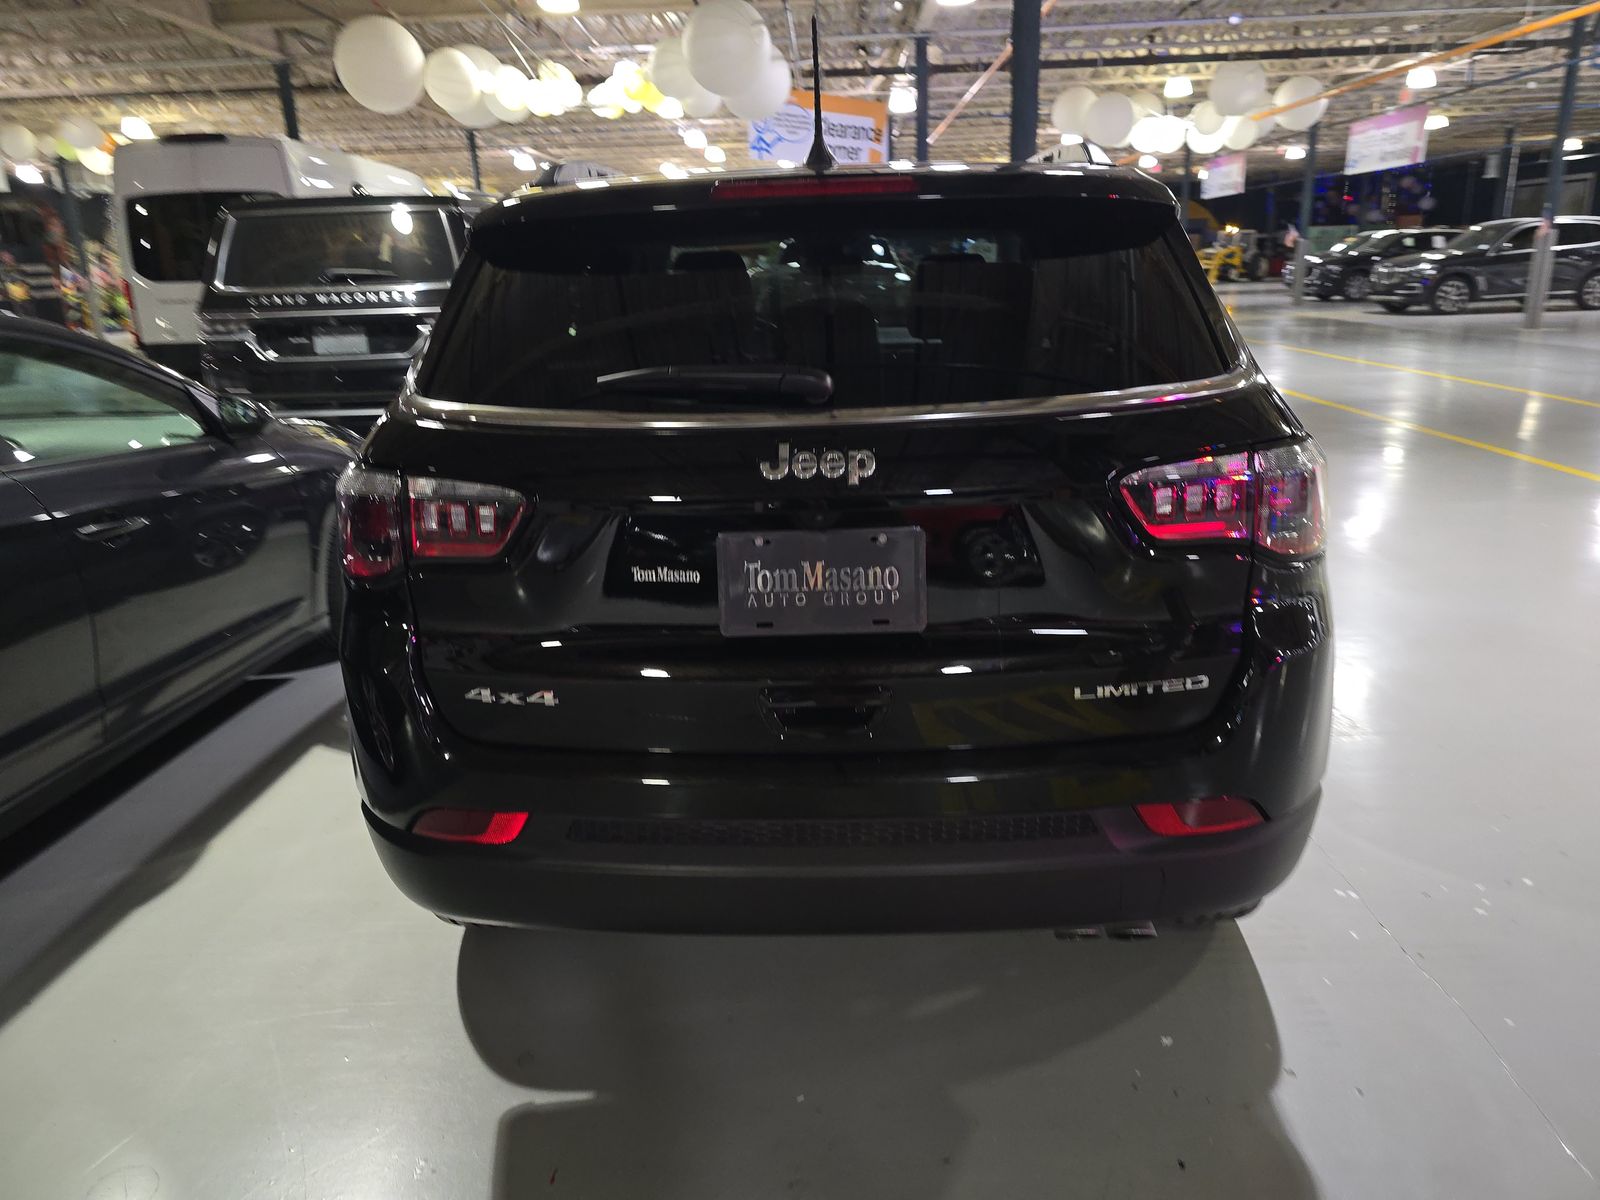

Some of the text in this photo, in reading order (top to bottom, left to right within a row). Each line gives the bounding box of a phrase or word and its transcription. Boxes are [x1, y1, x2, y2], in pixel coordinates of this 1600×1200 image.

[760, 441, 876, 485] Jeep
[631, 565, 700, 584] Tom Masano
[744, 560, 899, 594] Tom Masano
[748, 591, 900, 608] AUTO GROUP
[464, 686, 559, 707] 4x4
[1074, 674, 1210, 700] LIMITED
